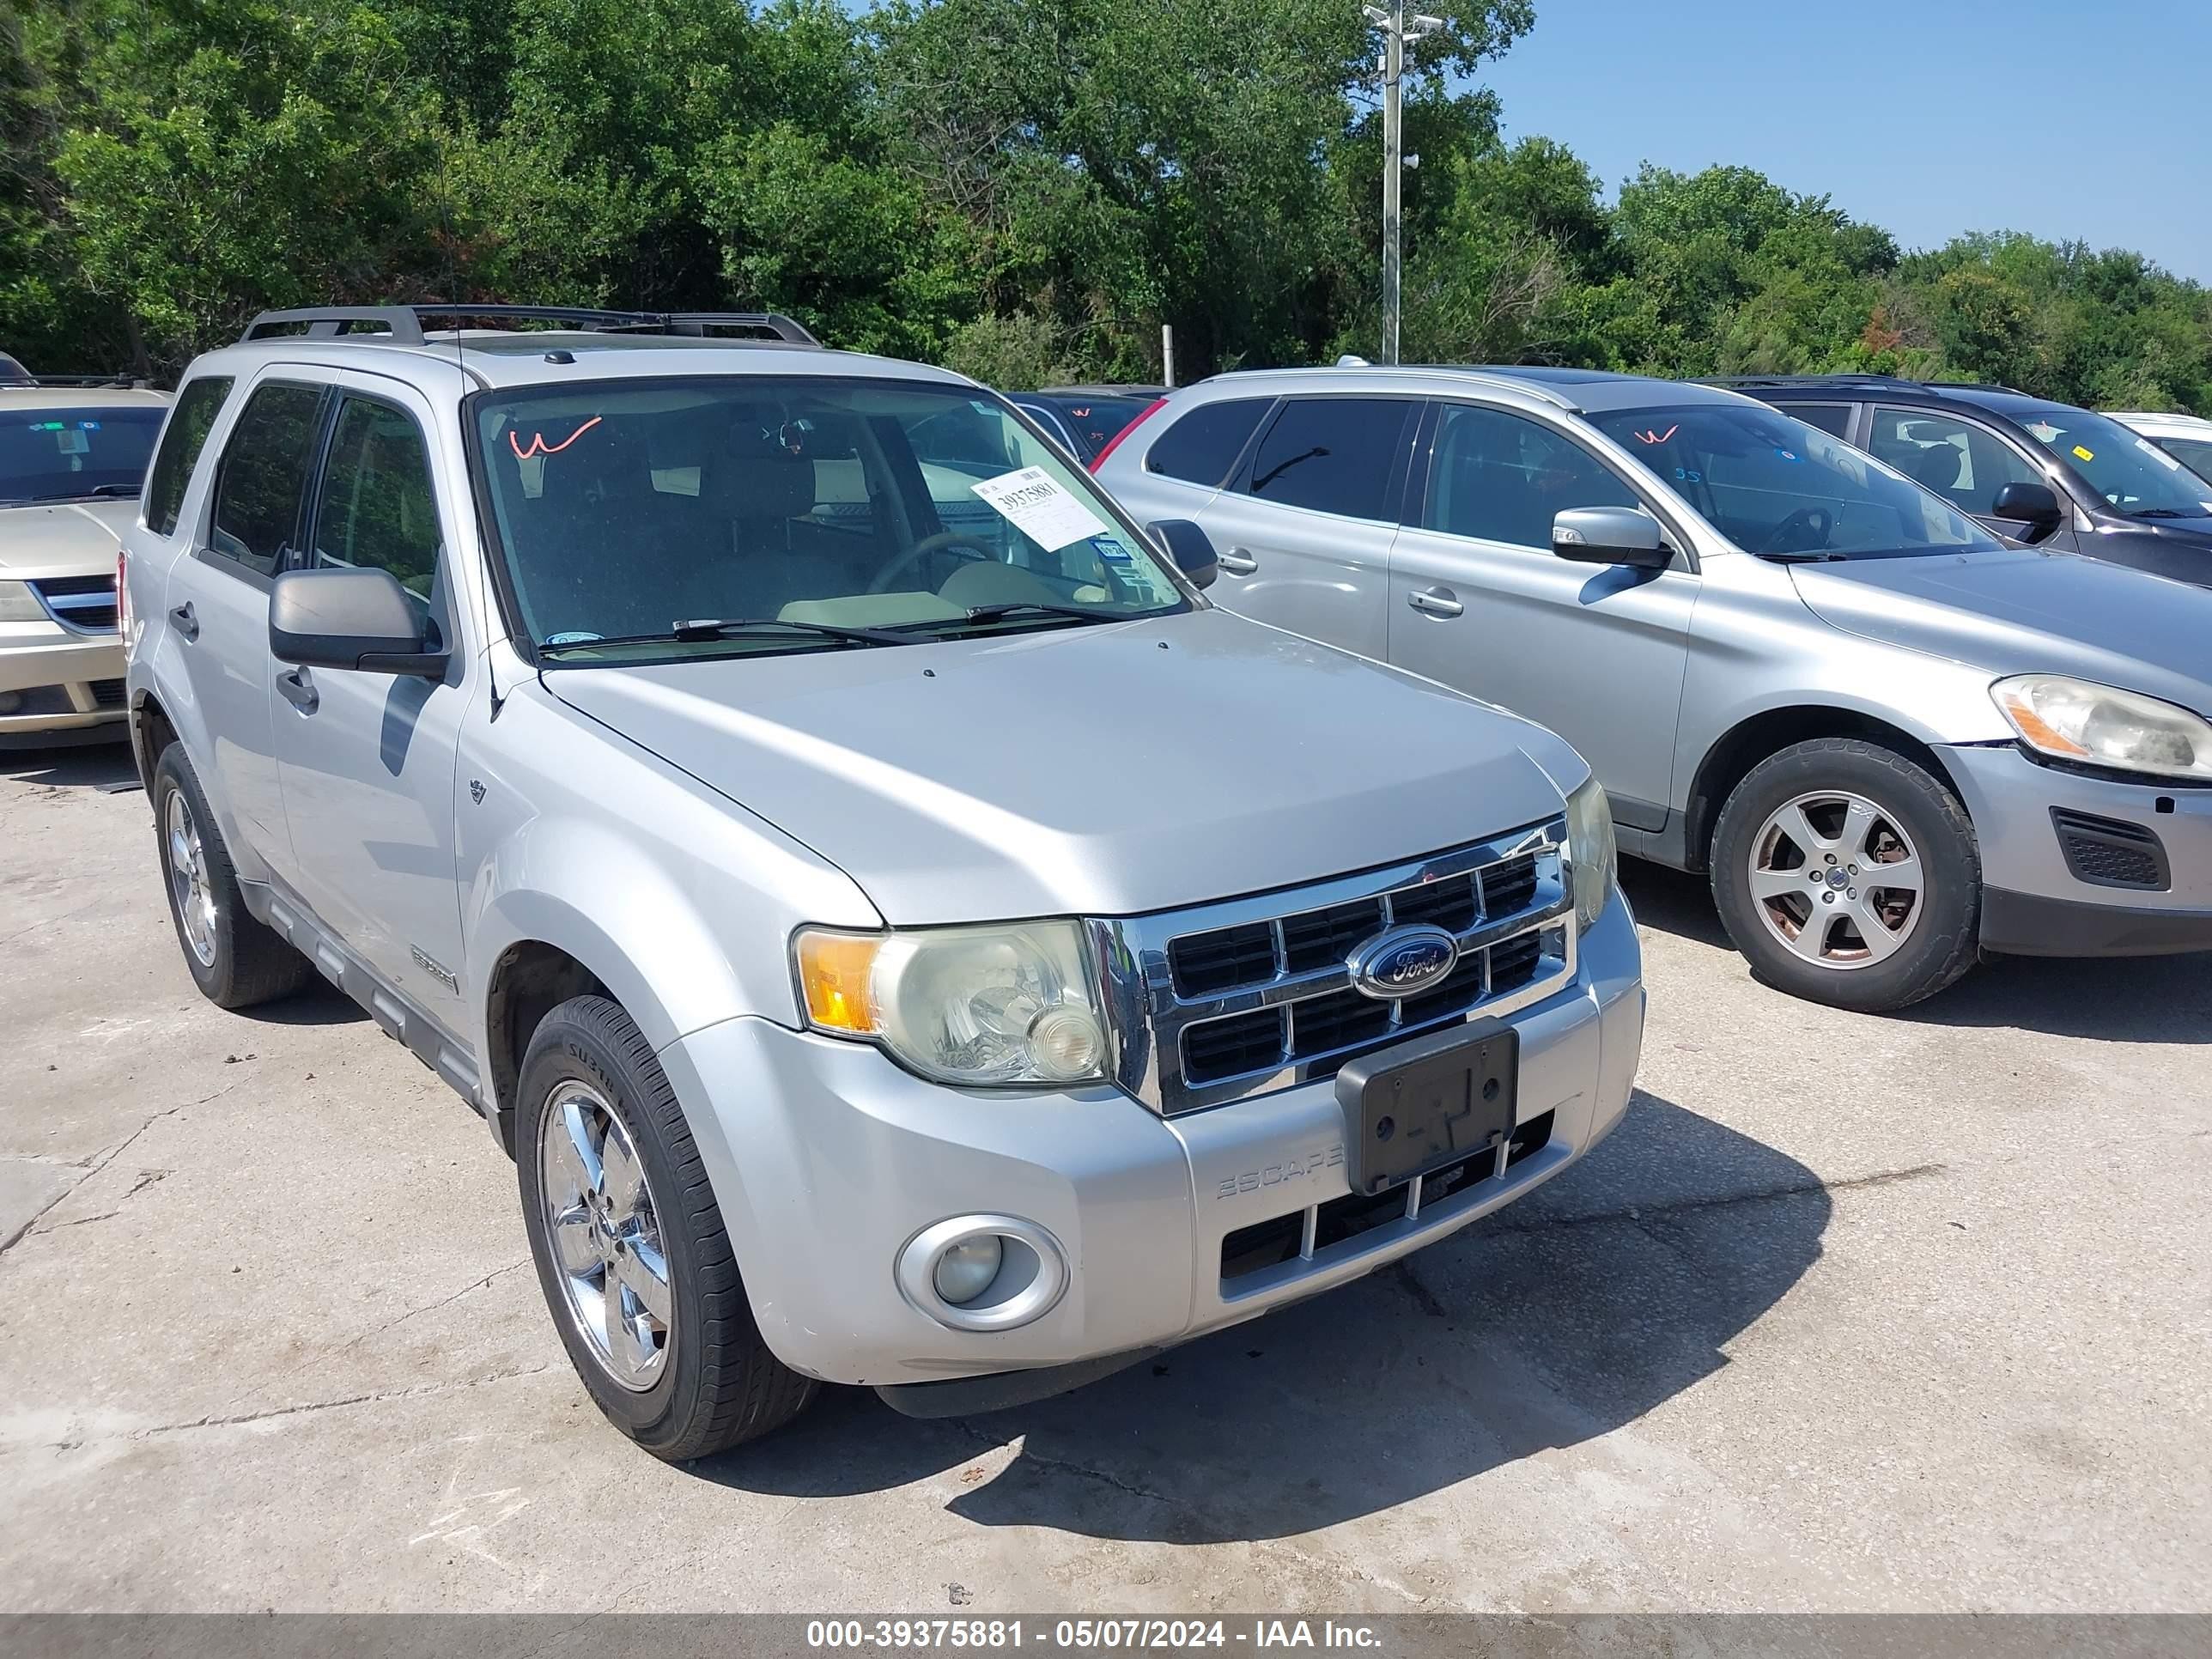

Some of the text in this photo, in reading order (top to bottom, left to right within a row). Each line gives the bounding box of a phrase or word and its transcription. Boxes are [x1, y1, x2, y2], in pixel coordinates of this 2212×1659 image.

[998, 483, 1058, 510] 39375881
[1393, 947, 1437, 981] Ford
[1217, 1143, 1346, 1200] ESCAPE
